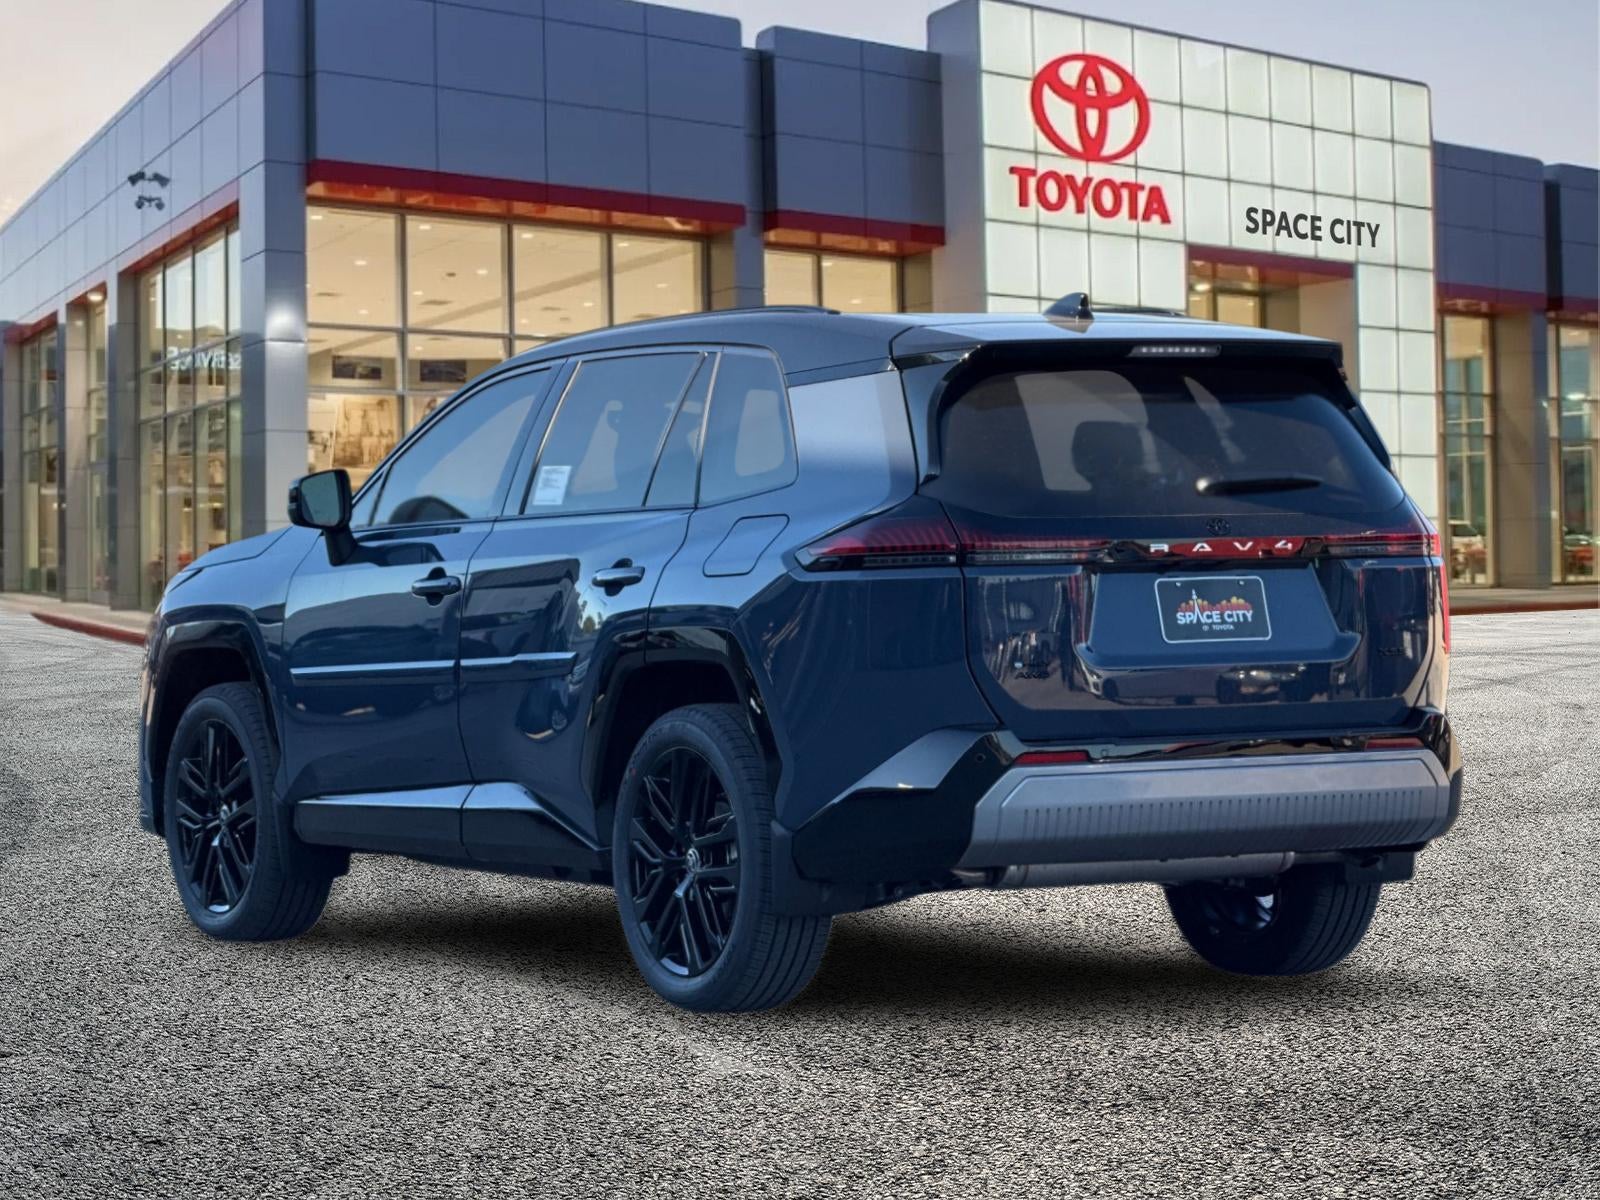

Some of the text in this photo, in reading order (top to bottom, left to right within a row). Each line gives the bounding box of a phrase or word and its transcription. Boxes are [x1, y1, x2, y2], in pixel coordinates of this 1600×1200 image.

[1009, 166, 1171, 224] TOYOTA
[1245, 206, 1381, 248] SPACE CITY
[1149, 539, 1293, 553] RAV4
[1176, 609, 1254, 625] SPACE CITY
